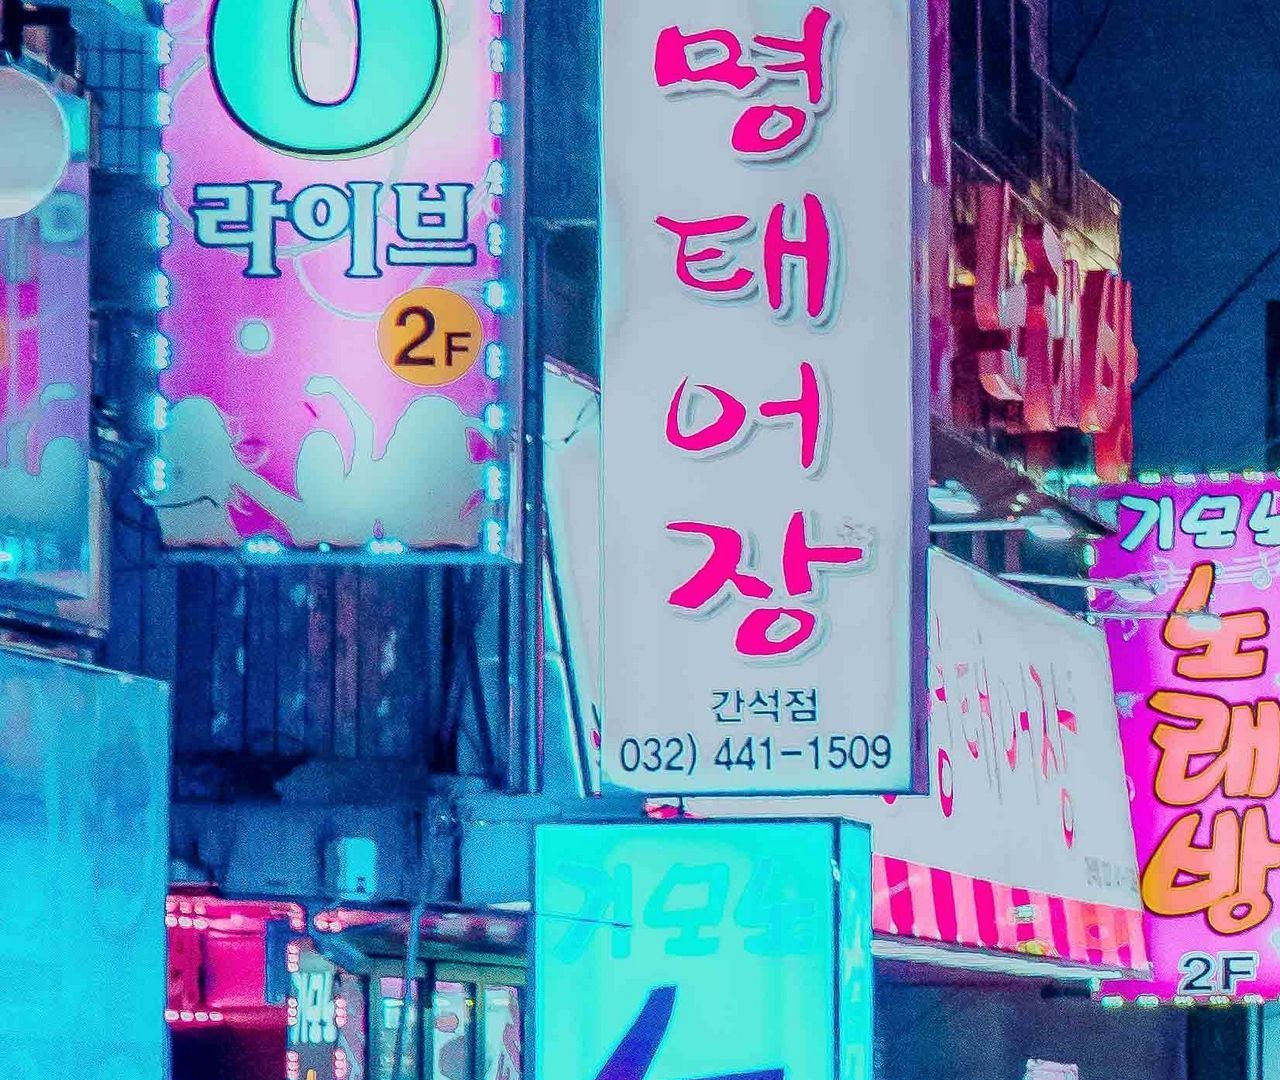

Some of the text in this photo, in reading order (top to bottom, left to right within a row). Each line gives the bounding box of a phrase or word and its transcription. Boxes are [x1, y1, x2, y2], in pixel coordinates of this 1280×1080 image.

[193, 181, 477, 278] 라이브
[393, 306, 471, 368] 2F
[654, 5, 863, 657] 명태어장
[710, 688, 820, 724] 간석점
[620, 734, 893, 775] 032) 441-1509
[1177, 950, 1260, 995] 2F
